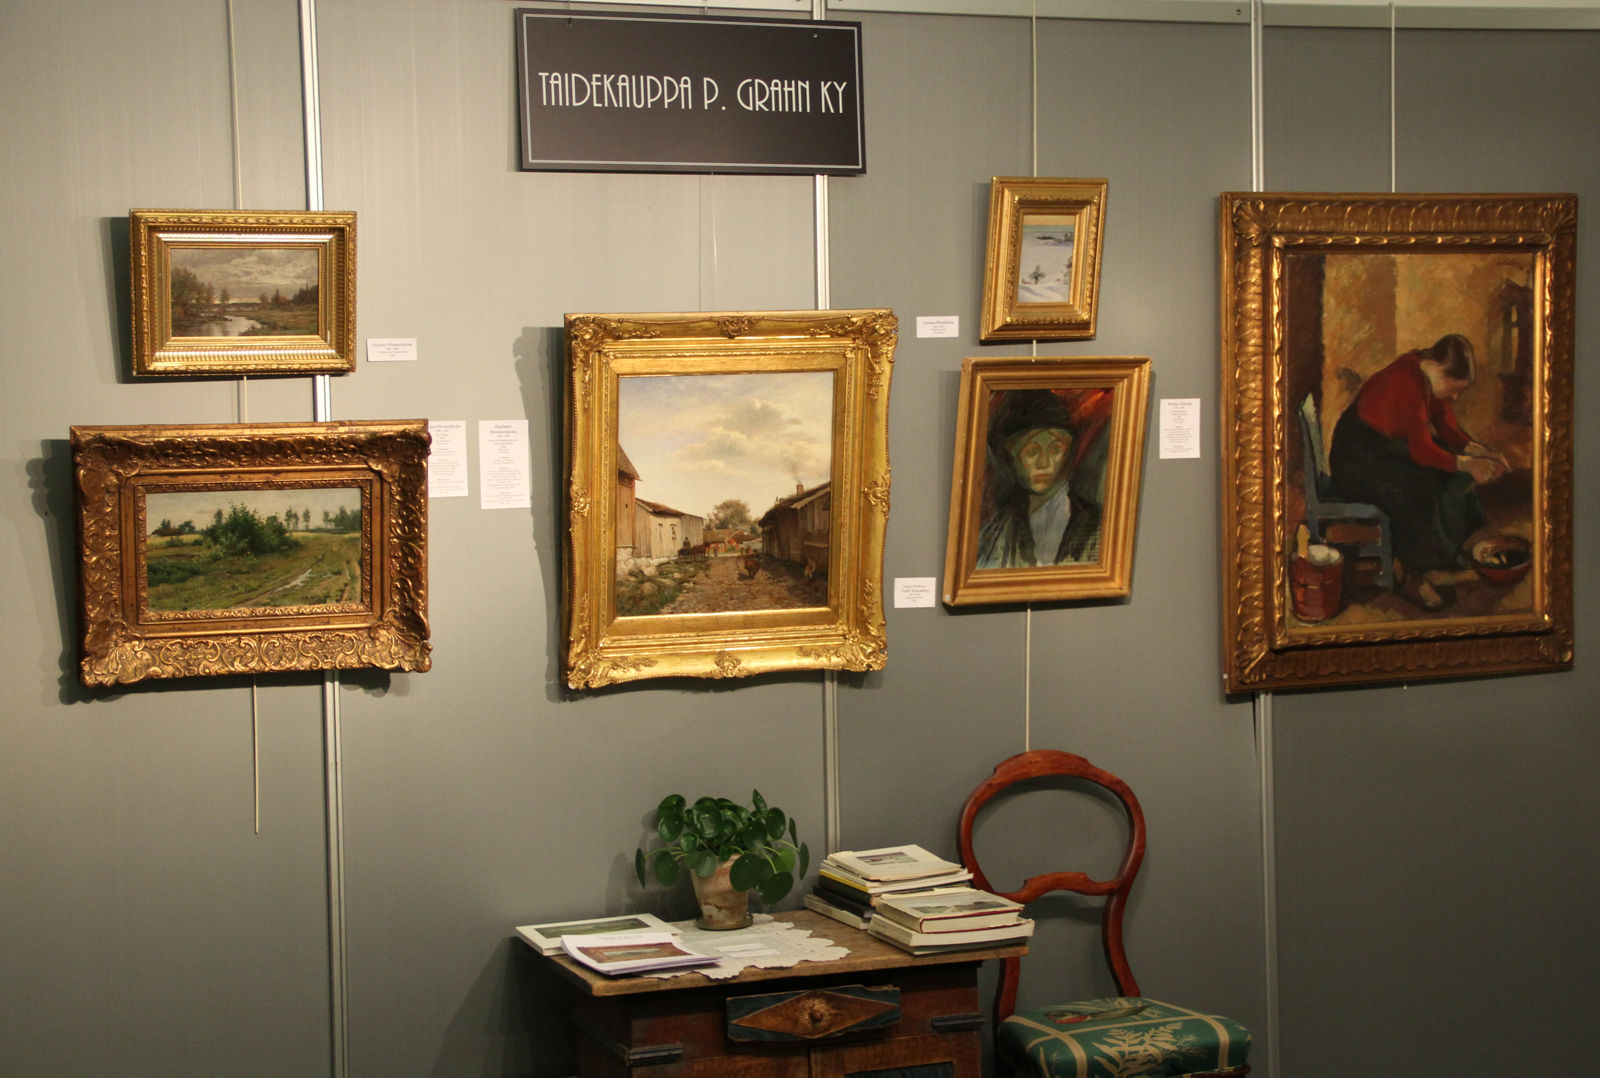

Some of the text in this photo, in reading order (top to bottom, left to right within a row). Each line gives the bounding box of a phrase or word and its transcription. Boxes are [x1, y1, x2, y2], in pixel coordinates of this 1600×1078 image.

[538, 72, 847, 114] TAIDEKAUPPA P. GRAHN KY
